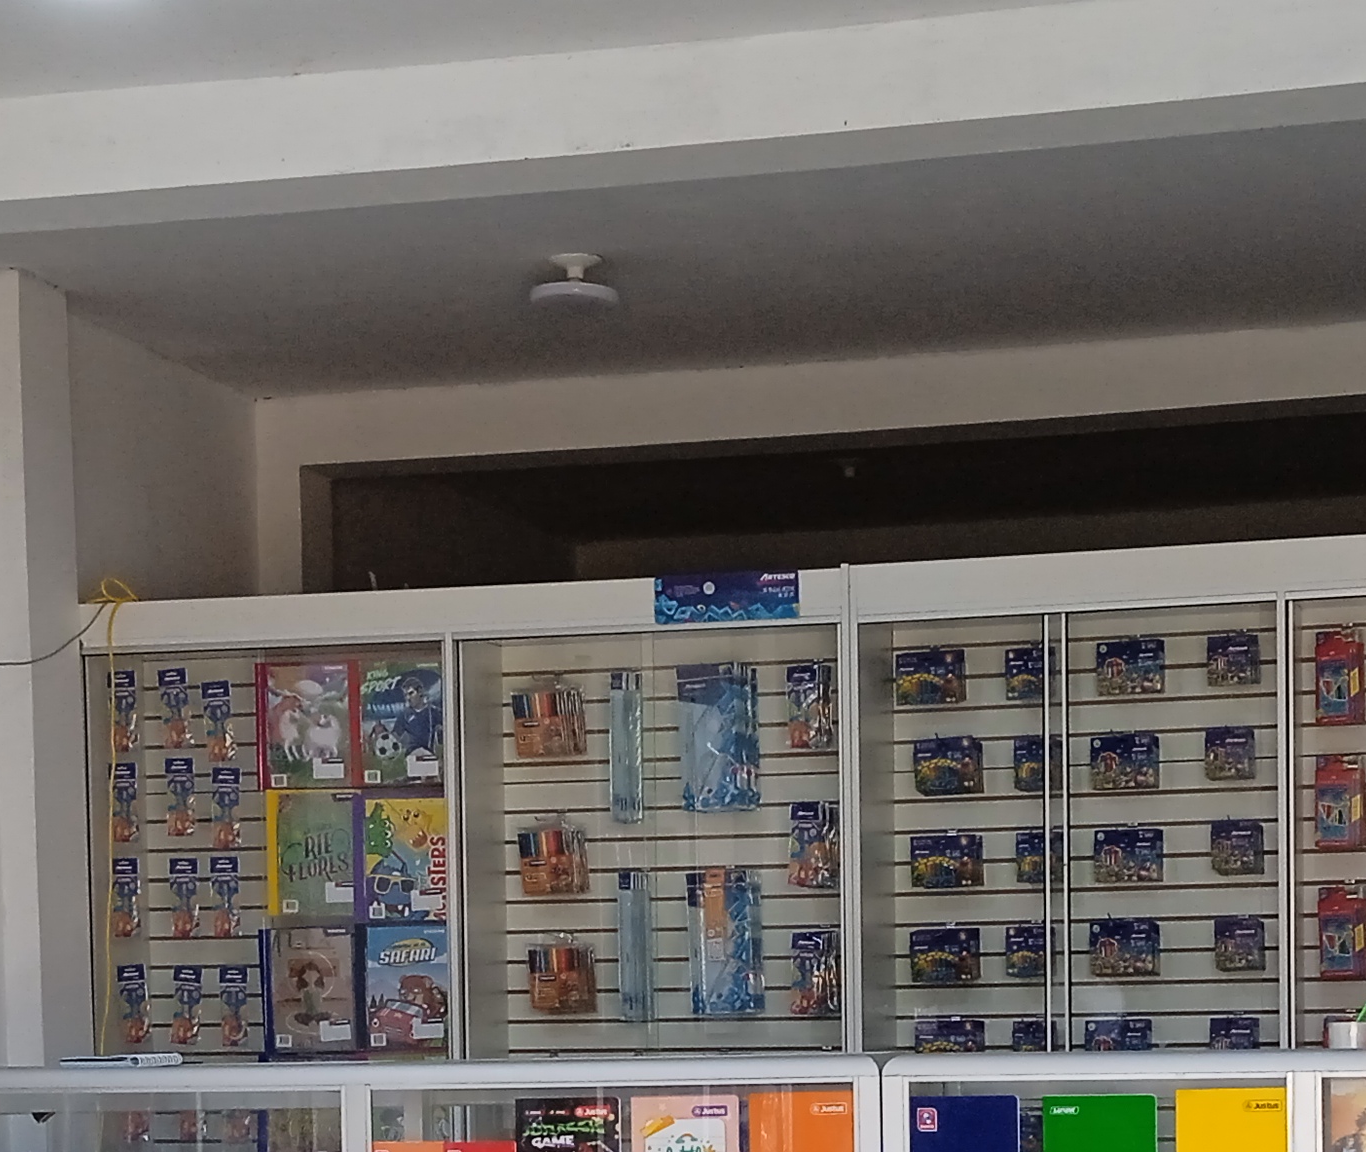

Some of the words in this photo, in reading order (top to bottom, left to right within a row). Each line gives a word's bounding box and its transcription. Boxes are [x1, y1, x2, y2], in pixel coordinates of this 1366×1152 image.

[379, 947, 436, 965] SAFARI
[1254, 1101, 1280, 1110] Justus
[531, 1135, 575, 1149] GAME
